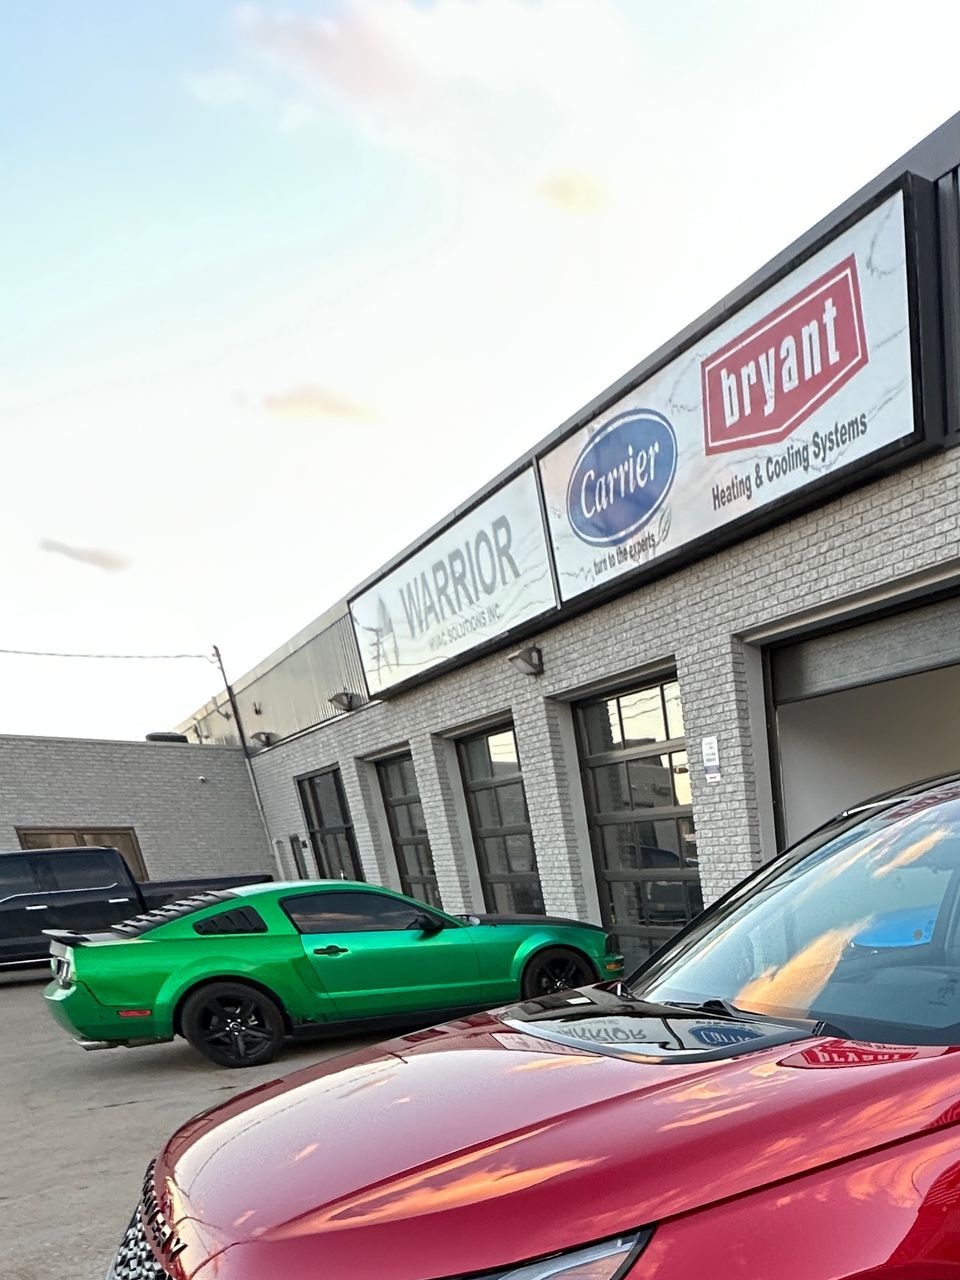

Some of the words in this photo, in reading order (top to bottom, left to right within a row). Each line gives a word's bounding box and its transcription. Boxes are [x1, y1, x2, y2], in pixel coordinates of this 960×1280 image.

[720, 297, 840, 428] bryant
[581, 441, 660, 519] Carrier
[712, 474, 752, 511] Heating
[755, 463, 763, 489] &
[766, 445, 809, 483] Cooling
[812, 413, 868, 463] Systems
[399, 514, 521, 640] WARRIOR
[593, 558, 608, 575] turn
[608, 551, 616, 568] to
[616, 545, 628, 565] the
